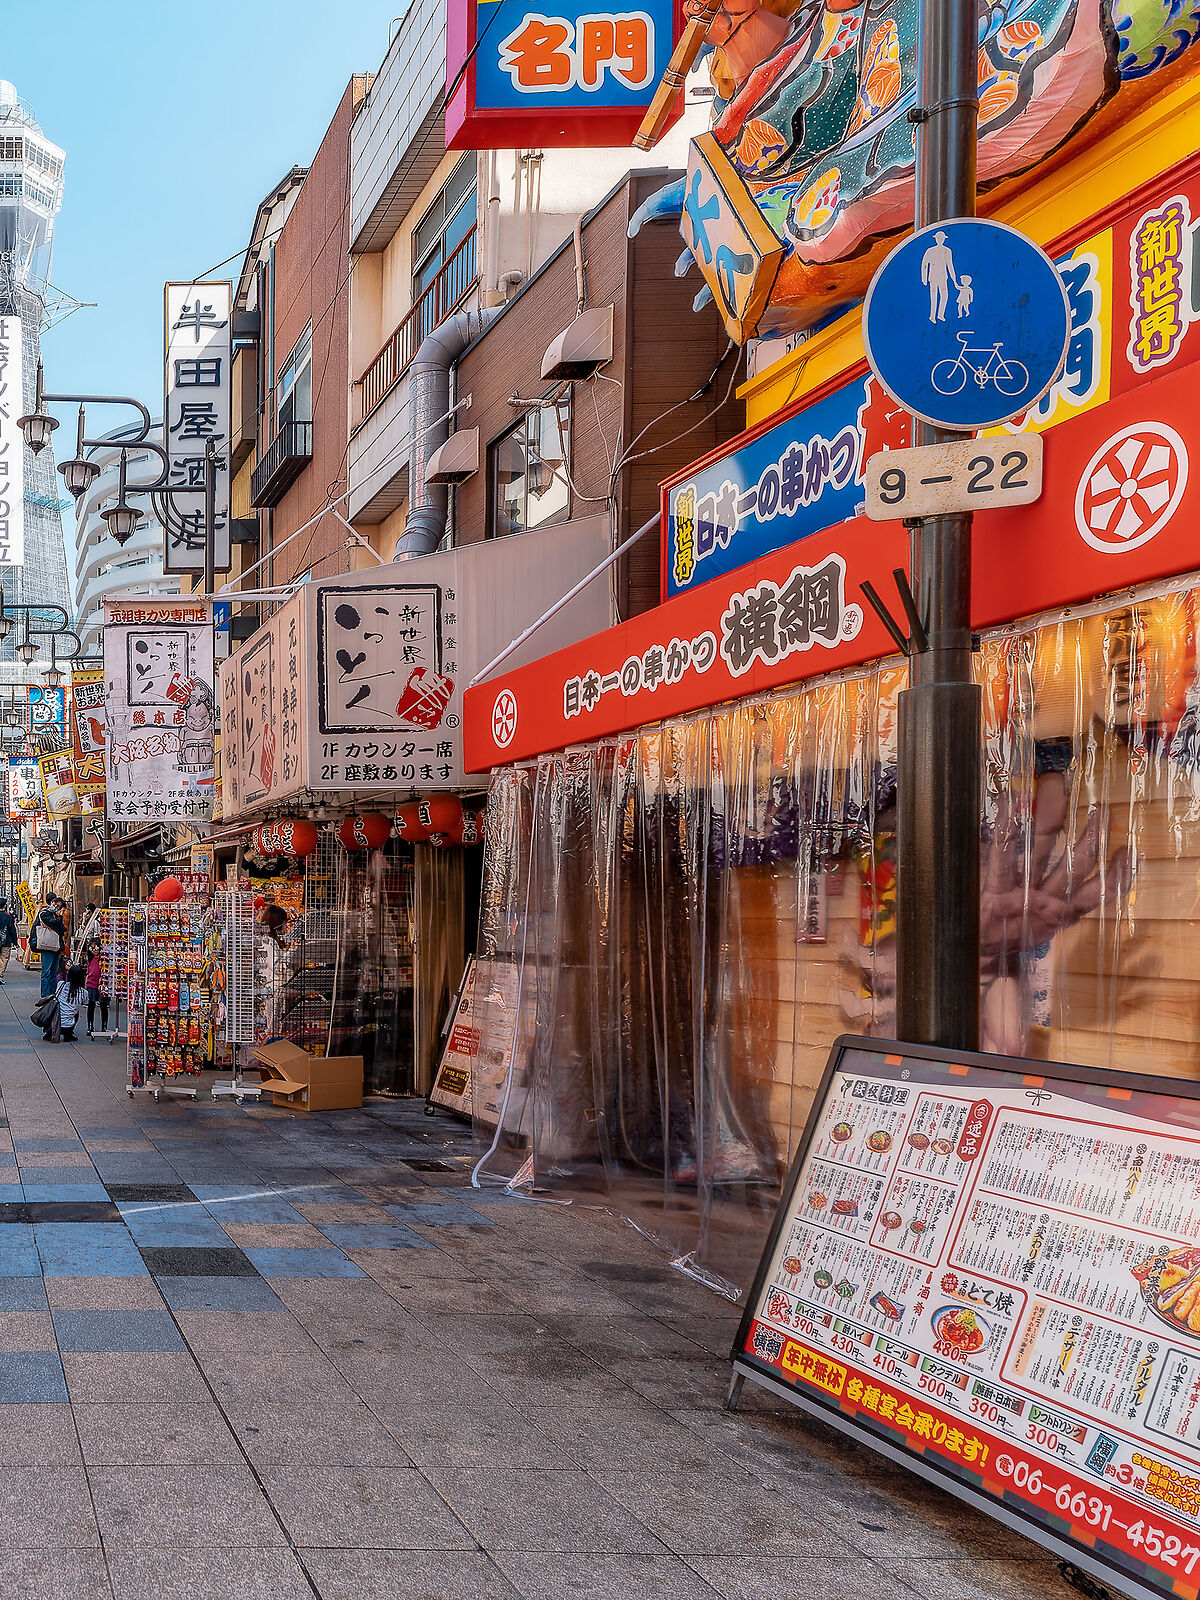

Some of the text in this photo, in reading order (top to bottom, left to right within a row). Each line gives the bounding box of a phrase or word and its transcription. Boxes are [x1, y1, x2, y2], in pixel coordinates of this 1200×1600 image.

[504, 18, 648, 87] 名門
[1136, 207, 1181, 362] 新世界
[697, 430, 856, 557] 日本一の串かつ
[675, 489, 694, 582] 新世界
[109, 609, 208, 623] 元祖串カツ専門店
[724, 560, 841, 670] 横綱
[398, 604, 428, 665] 新世界
[563, 636, 714, 716] 日本一の串かつ
[132, 709, 187, 726] 総本店
[76, 752, 107, 779] 大
[111, 732, 182, 766] 大阪名物
[322, 741, 454, 758] 1F カウンター席
[20, 766, 37, 800] 串カツ
[320, 763, 454, 781] 2F 座敷あります
[112, 800, 211, 816] 宴会予約受付中
[959, 1120, 985, 1155] 逸品
[1119, 1155, 1146, 1202] 魚介串
[1017, 1224, 1048, 1284] 変わり種串
[966, 1280, 1017, 1315] どて焼
[1139, 1257, 1168, 1306] 野菜串
[798, 1305, 829, 1324] ハイボール
[842, 1324, 864, 1340] 酎ハイ
[1058, 1313, 1068, 1333] バナナ
[752, 1331, 782, 1358] 横綱
[885, 1343, 909, 1360] ビール
[932, 1338, 969, 1364] 480円
[1049, 1325, 1080, 1390] デザート串
[784, 1345, 844, 1390] 年中無休
[928, 1362, 961, 1384] カクテル
[1167, 1363, 1187, 1398] 10本盛り
[975, 1383, 1020, 1412] 焼酎・日本酒
[1124, 1353, 1157, 1421] タルタル串
[844, 1375, 992, 1468] 各種宴会承ります!
[1032, 1409, 1082, 1439] ソフトドリンク
[1090, 1437, 1113, 1472] 横綱
[1010, 1459, 1200, 1576] 06-6631-4527
